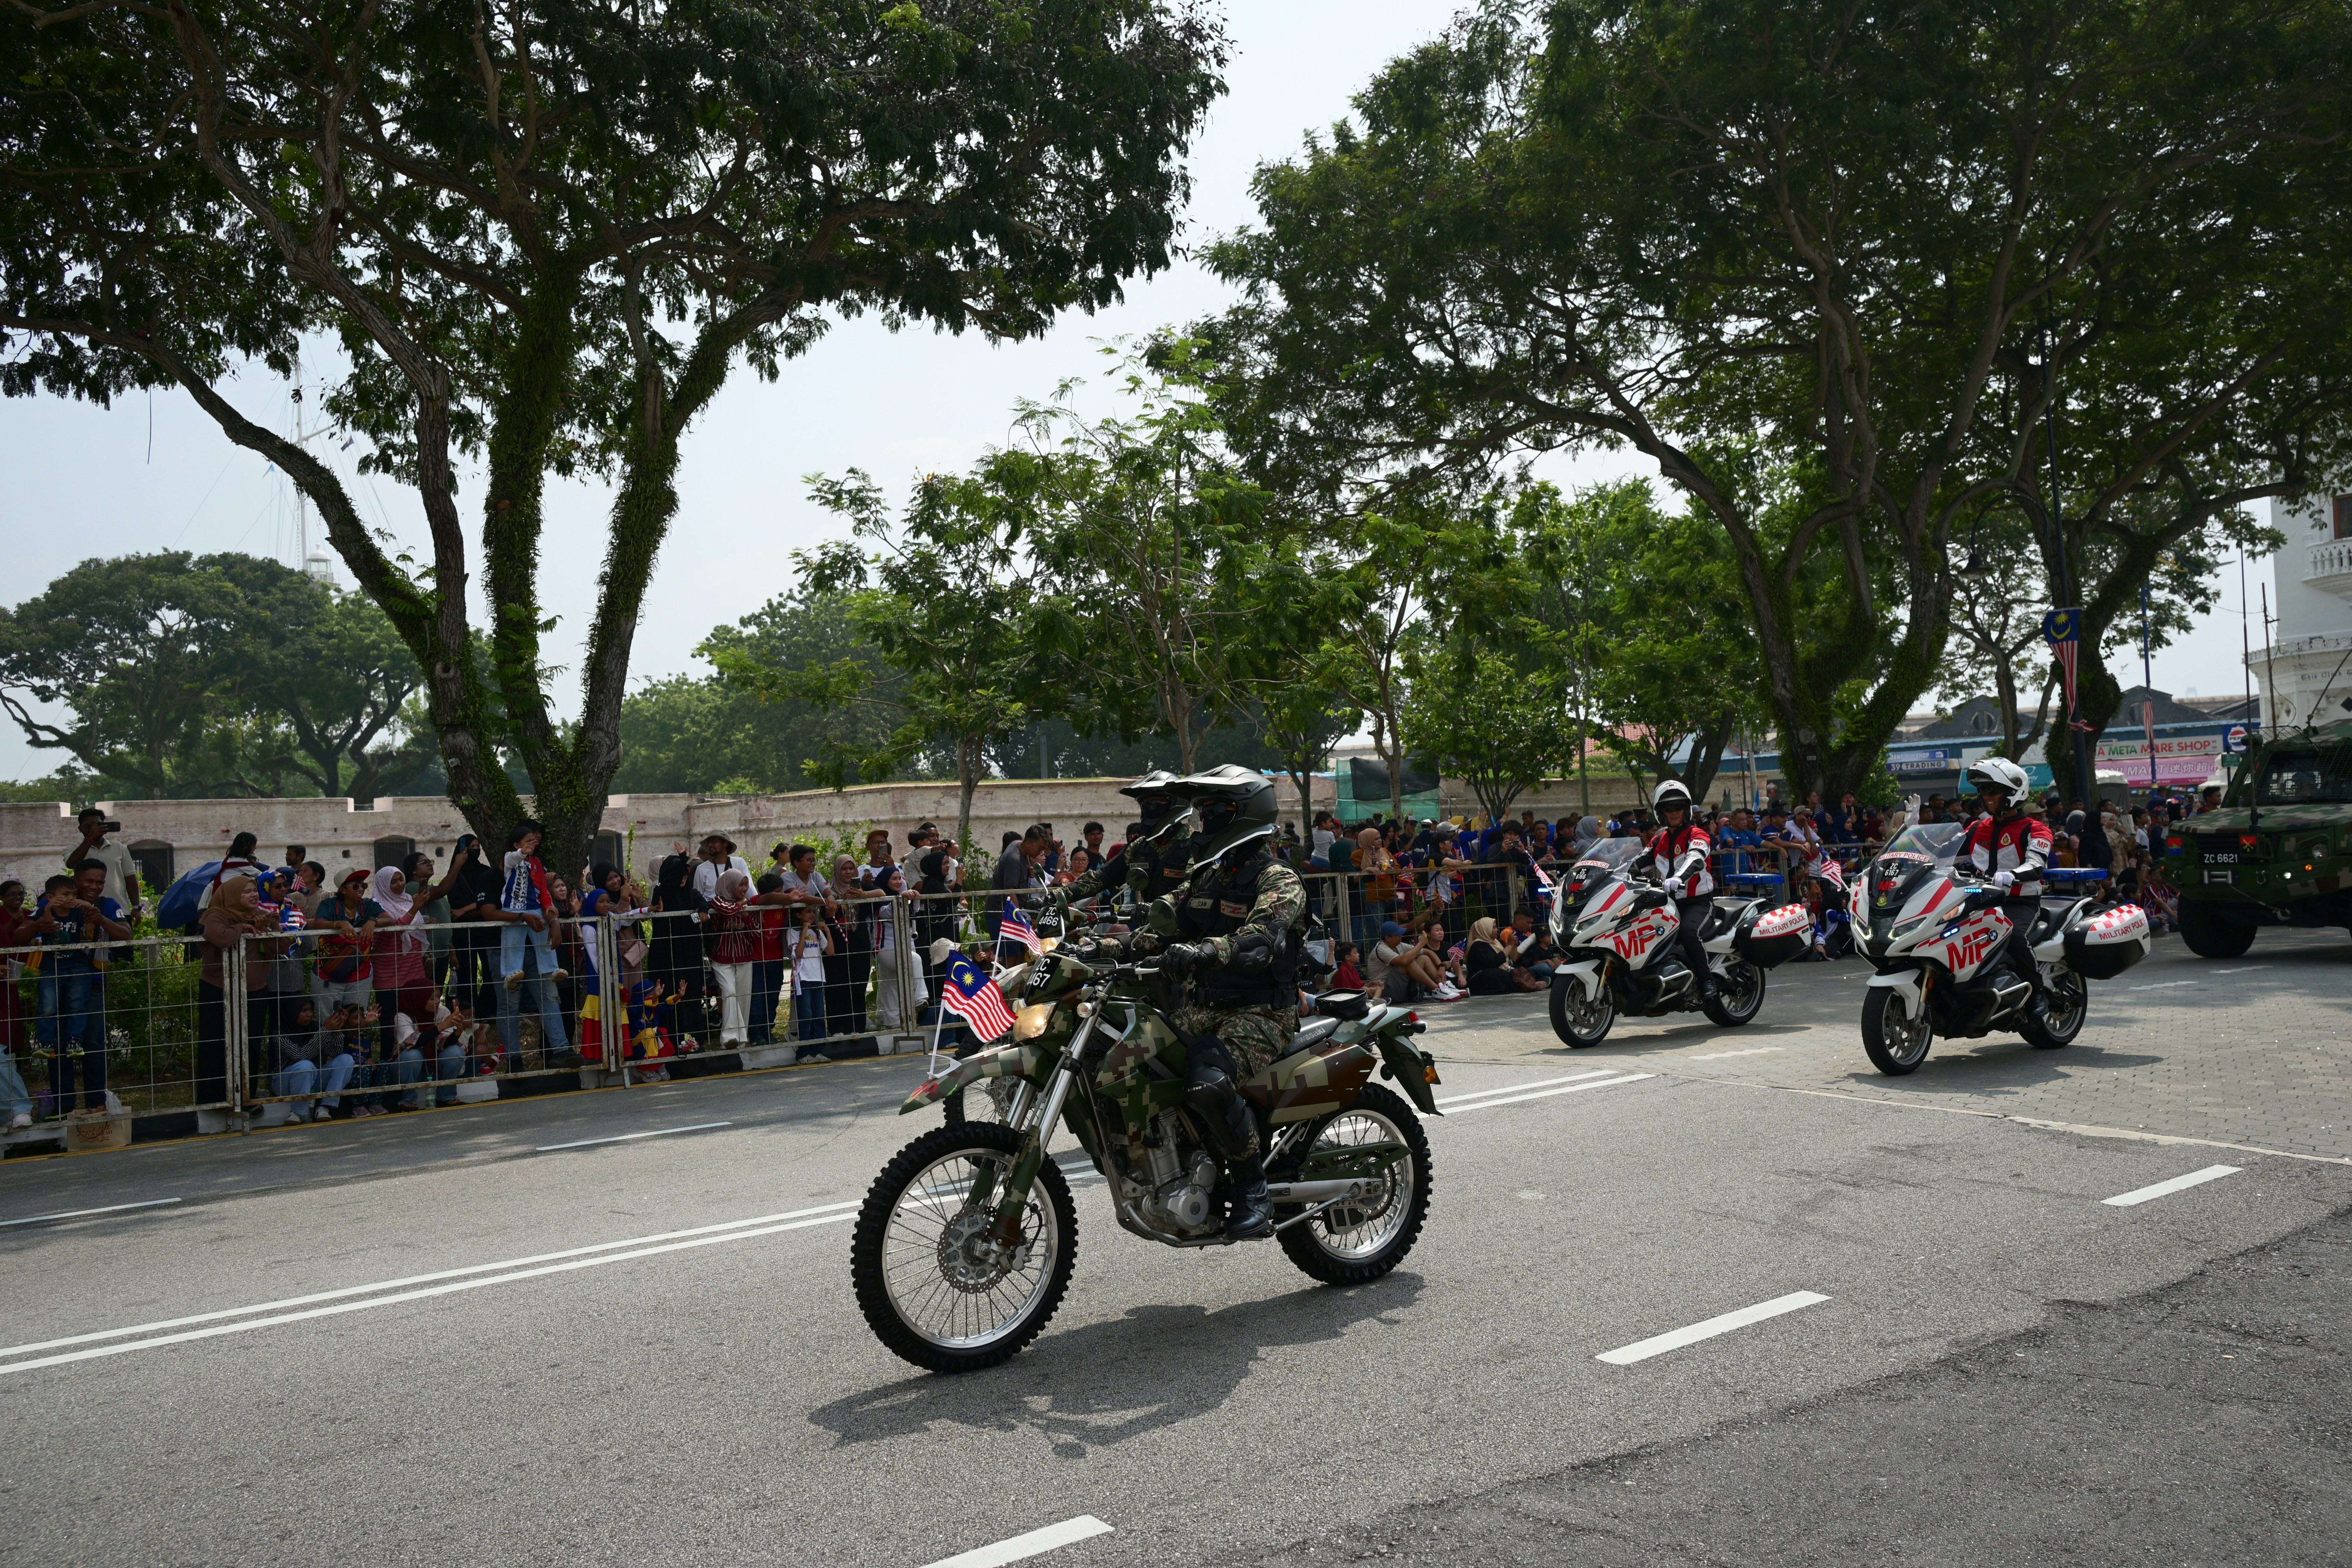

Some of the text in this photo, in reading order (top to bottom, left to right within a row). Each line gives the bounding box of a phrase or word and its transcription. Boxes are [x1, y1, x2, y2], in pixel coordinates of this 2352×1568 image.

[2109, 745, 2137, 755] META
[2177, 740, 2210, 751] SHOP
[2037, 840, 2048, 849] MP
[1904, 853, 1929, 861] POLICE
[2204, 854, 2238, 863] ZC 6621
[1878, 881, 1897, 891] MP
[1046, 907, 1056, 915] ZC
[1038, 916, 1059, 926] 4466
[1759, 914, 1805, 935] MILITARY POLICE
[2099, 925, 2132, 940] MILITARY
[1613, 925, 1656, 959] MP
[1946, 927, 1992, 972] MP
[1035, 958, 1050, 971] ZC
[1027, 972, 1051, 987] 4467
